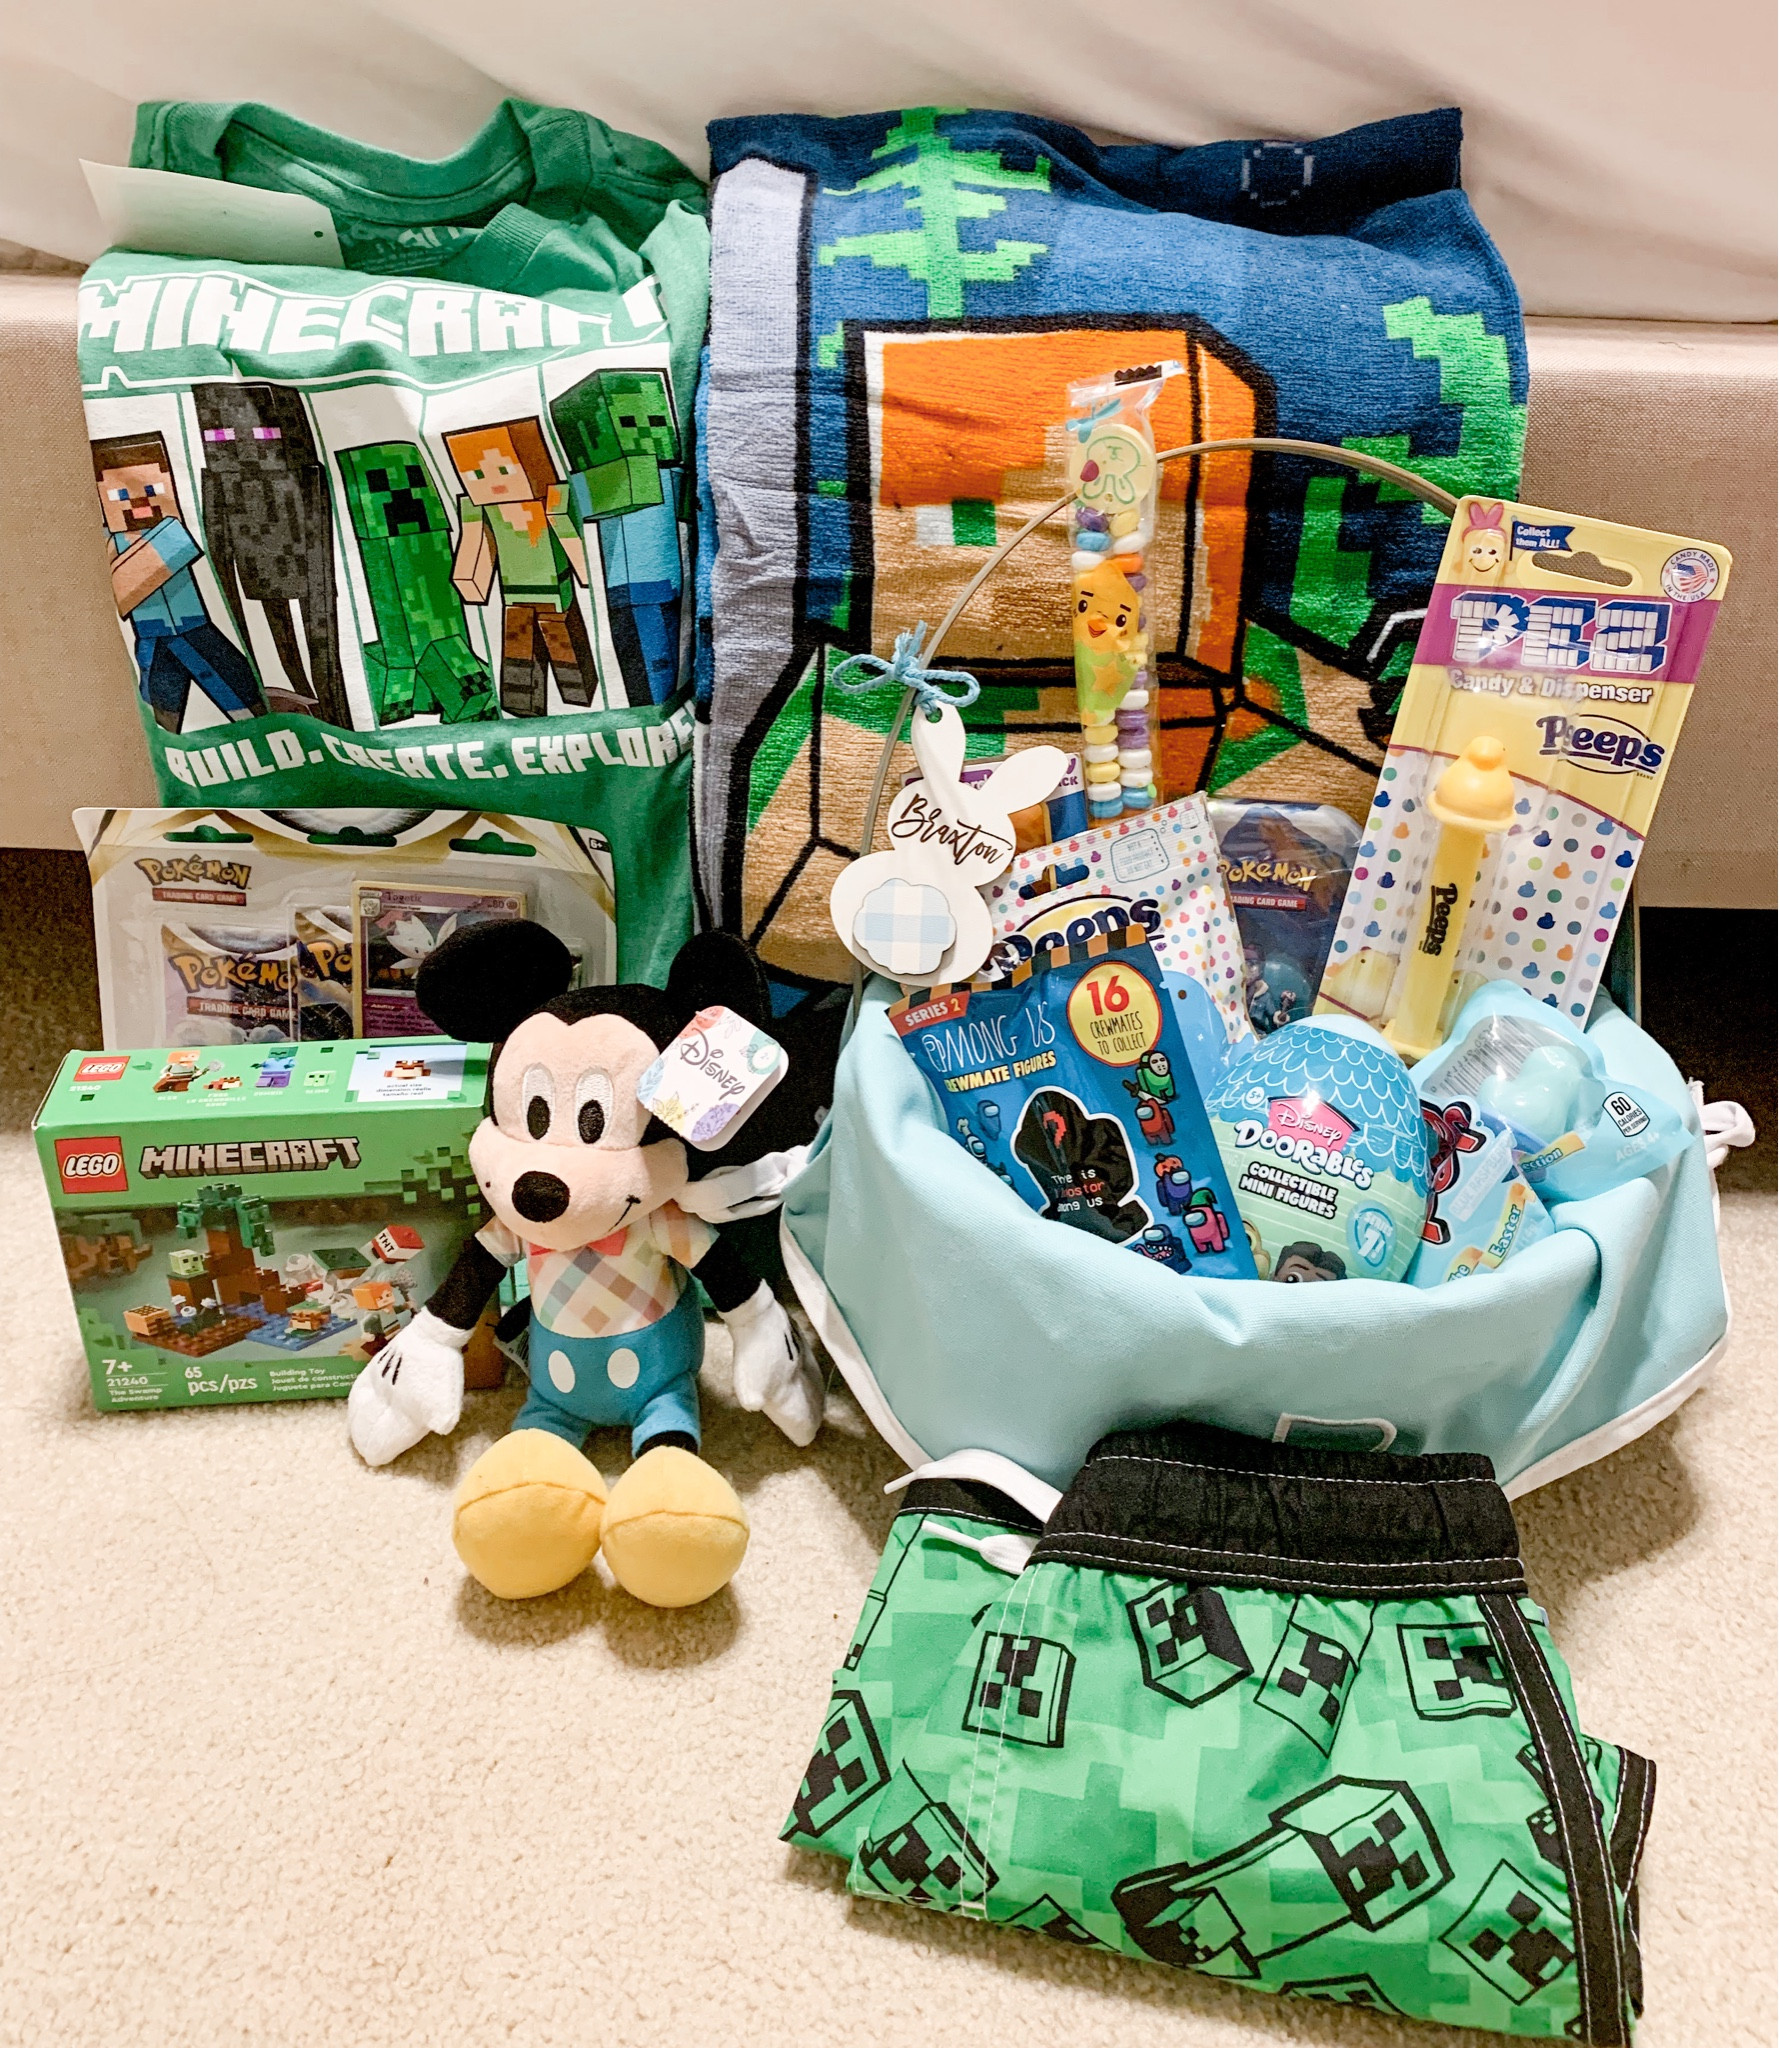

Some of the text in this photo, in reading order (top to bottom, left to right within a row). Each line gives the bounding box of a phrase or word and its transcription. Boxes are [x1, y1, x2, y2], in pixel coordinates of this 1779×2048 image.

[1517, 525, 1550, 537] Collect
[1516, 538, 1560, 548] them ALL!
[1670, 551, 1715, 572] CANDY MADE
[1665, 584, 1705, 600] IN THE USA
[1450, 591, 1672, 674] PEZ
[1451, 669, 1652, 704] Candy & Dispenser
[1536, 714, 1666, 770] Peeps
[164, 729, 325, 788] BUILD.
[320, 732, 510, 780] CREATE.
[891, 793, 1014, 865] Braxton
[590, 839, 603, 849] 6+
[134, 854, 252, 890] Pokémon
[1217, 856, 1317, 892] Pokémon
[195, 893, 215, 901] CARD
[217, 894, 238, 902] GAME
[1256, 897, 1275, 906] CARD
[1277, 899, 1298, 908] GAME
[1423, 883, 1459, 956] Peeps
[1086, 975, 1130, 1016] 16
[200, 1002, 240, 1015] TRADING
[242, 1006, 266, 1017] CARD
[905, 998, 961, 1026] SERIES 2
[1025, 1001, 1056, 1048] US
[1089, 1011, 1143, 1039] CREWMATES
[1097, 1031, 1147, 1055] TO COLLECT
[79, 1062, 125, 1075] LEGO
[680, 1027, 746, 1101] Disney
[1012, 1050, 1057, 1078] FIGURES
[1249, 1091, 1262, 1100] 5+
[1610, 1096, 1632, 1116] 60
[1277, 1102, 1343, 1147] Disney
[1617, 1108, 1643, 1128] CALORIES
[1622, 1115, 1648, 1136] PER SERVING
[139, 1136, 362, 1180] MINECRAFT
[1234, 1119, 1374, 1190] DOORABLES
[64, 1155, 121, 1178] LEGO
[1081, 1169, 1096, 1179] is
[1248, 1162, 1338, 1203] COLLECTIBLE
[1240, 1175, 1337, 1219] MINI FIGURES
[1489, 1204, 1522, 1258] Easter
[379, 1233, 395, 1252] TNT
[102, 1359, 133, 1375] 7+
[184, 1366, 203, 1379] 65
[269, 1369, 306, 1377] Building
[106, 1376, 149, 1387] 21240
[128, 1387, 162, 1395] Swamp
[187, 1374, 258, 1396] pcs/pzs
[272, 1377, 296, 1385] Jouet
[272, 1384, 308, 1392] Juguete
[310, 1382, 331, 1390] para
[111, 1395, 160, 1403] Adventure
